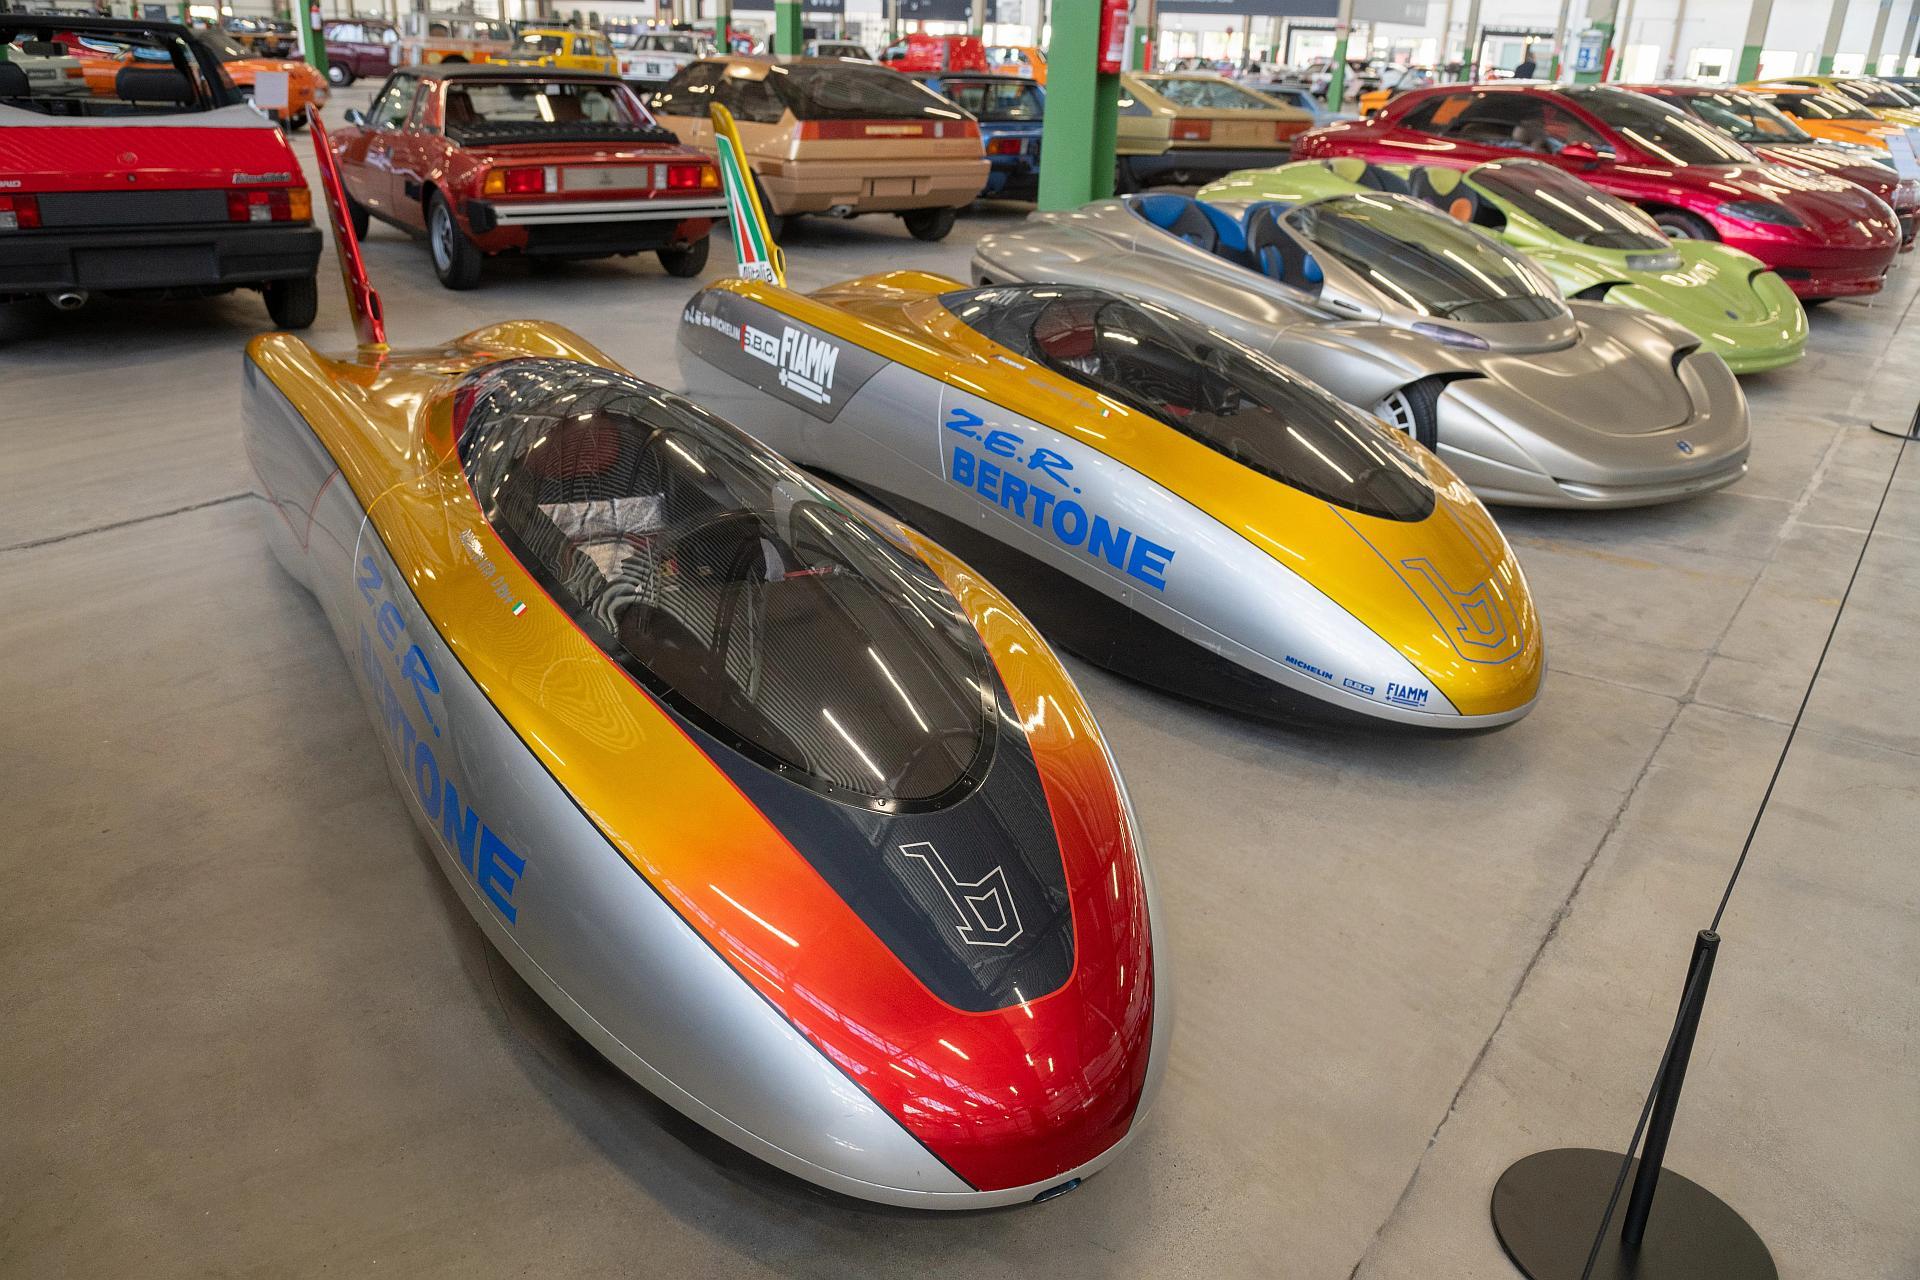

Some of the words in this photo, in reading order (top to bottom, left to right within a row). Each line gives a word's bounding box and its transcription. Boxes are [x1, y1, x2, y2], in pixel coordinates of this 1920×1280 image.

[780, 326, 840, 389] FIAMM
[946, 409, 1081, 494] Z.E.R.
[952, 447, 1176, 593] BERTONE
[1285, 655, 1333, 680] MICHELIN
[1387, 682, 1428, 702] FIAMM
